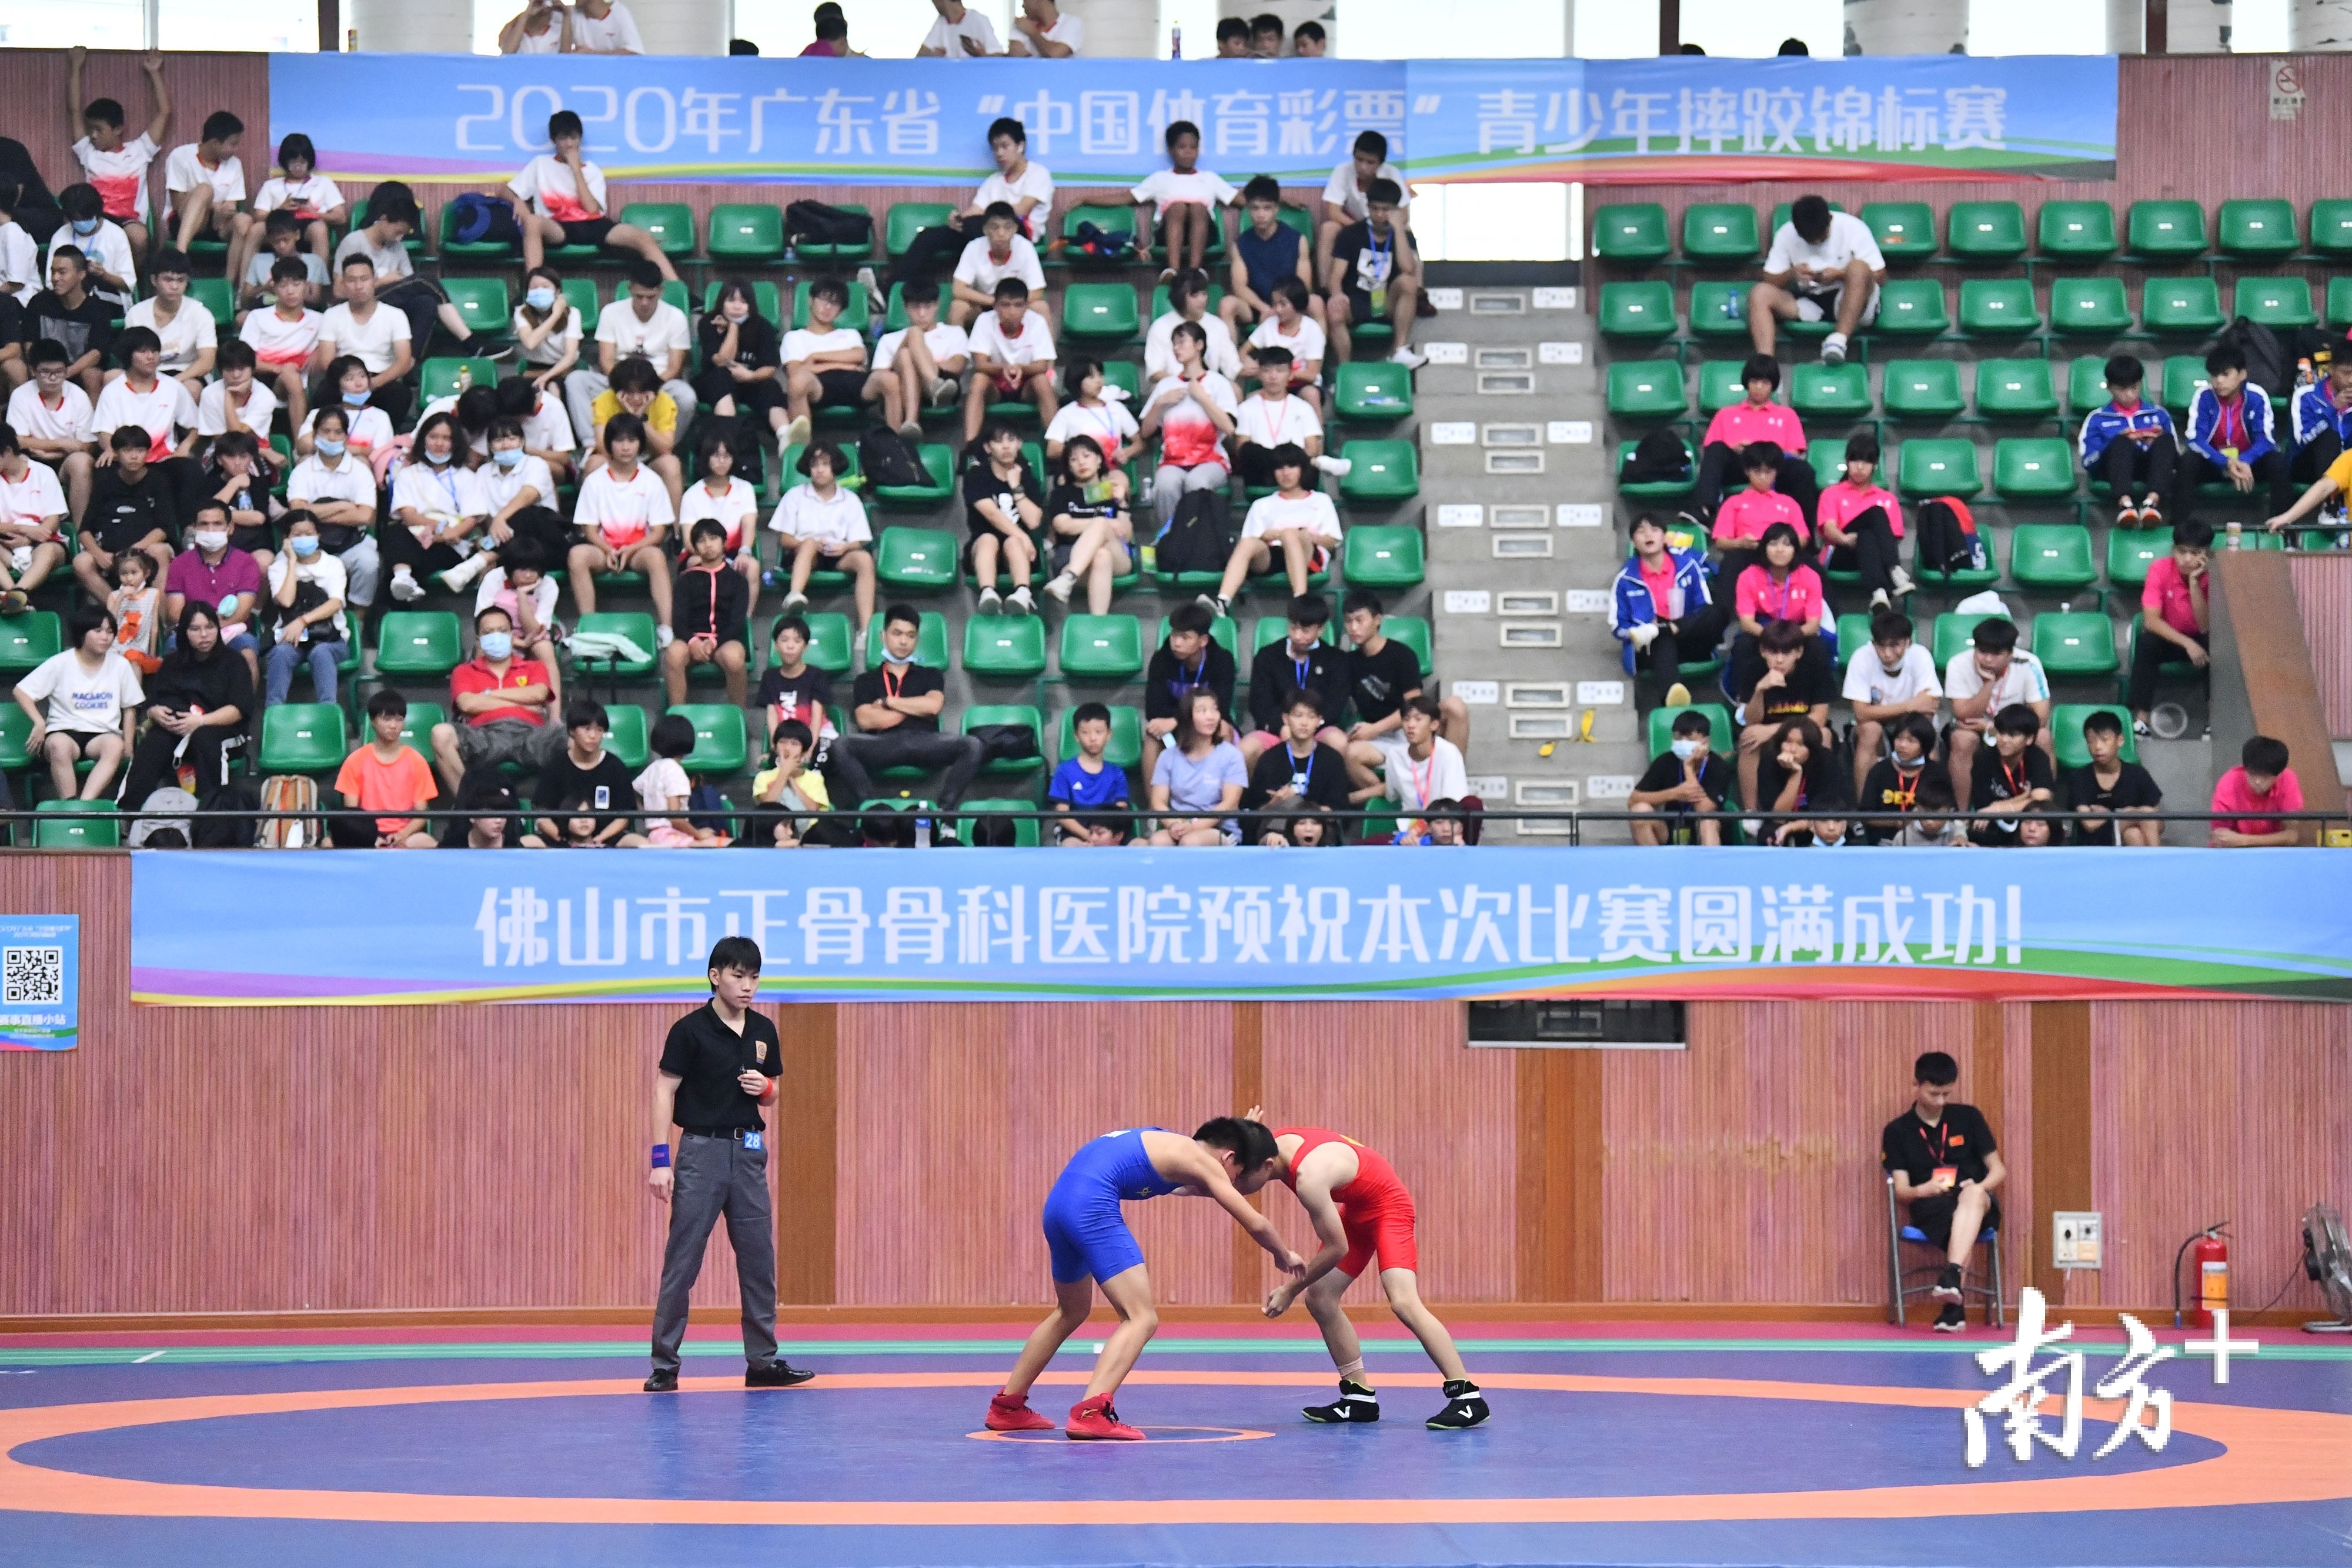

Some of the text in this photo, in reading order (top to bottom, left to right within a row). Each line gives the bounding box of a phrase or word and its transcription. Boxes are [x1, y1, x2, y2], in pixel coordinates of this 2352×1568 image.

[1476, 86, 2007, 155] 青少年摔跤锦标赛
[473, 884, 2021, 966] 佛山市正骨骨科医院预祝本次比赛圆满成功!
[746, 1133, 760, 1149] 28
